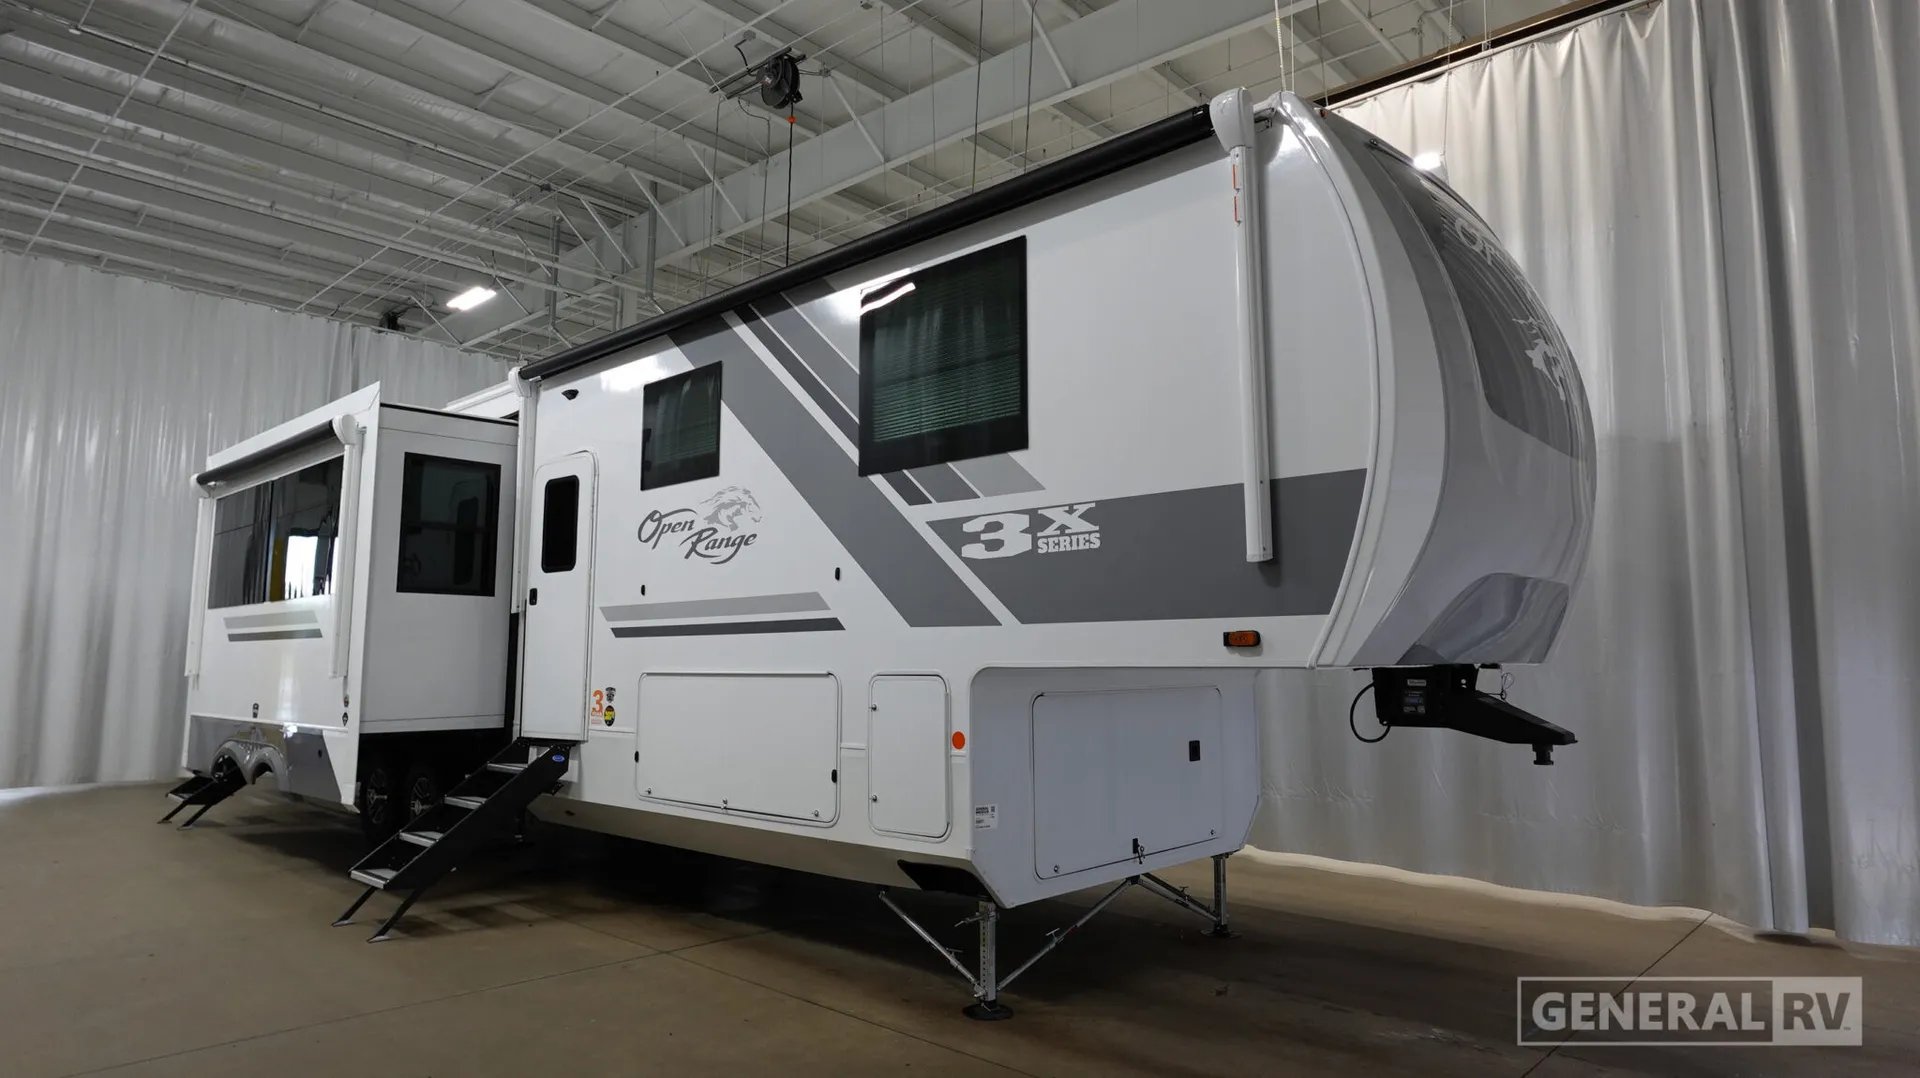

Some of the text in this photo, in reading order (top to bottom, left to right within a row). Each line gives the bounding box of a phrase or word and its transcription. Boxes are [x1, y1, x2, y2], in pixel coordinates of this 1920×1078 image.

[638, 508, 698, 550] Open
[679, 526, 758, 565] Range
[1037, 532, 1101, 554] SERIES
